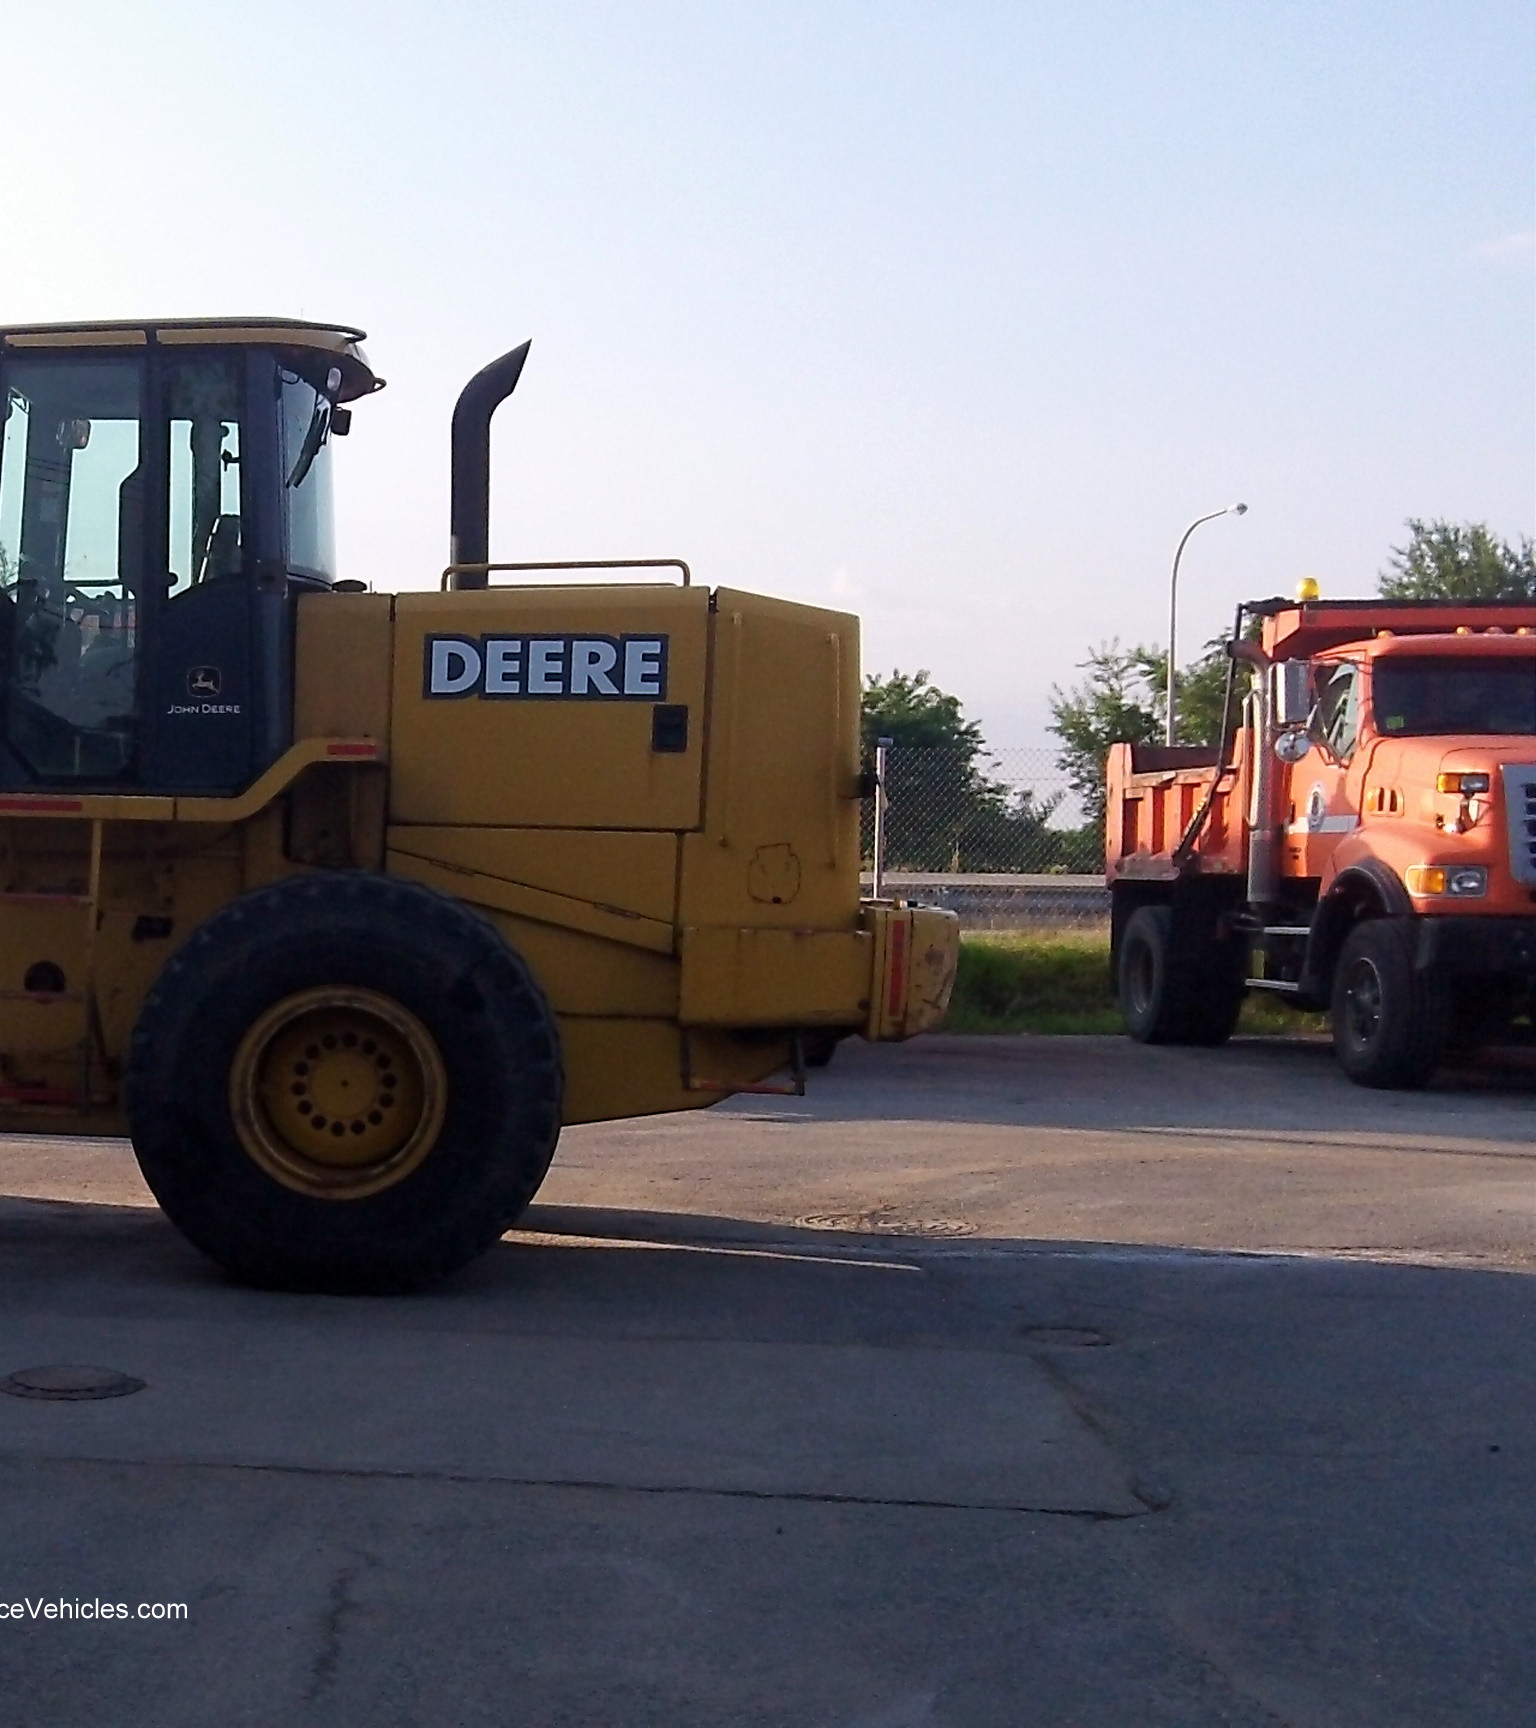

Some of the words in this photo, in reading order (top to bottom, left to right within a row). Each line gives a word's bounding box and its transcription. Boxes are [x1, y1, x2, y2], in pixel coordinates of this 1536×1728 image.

[430, 640, 662, 695] DEERE
[166, 704, 200, 715] JOHN
[201, 703, 241, 714] DEERE
